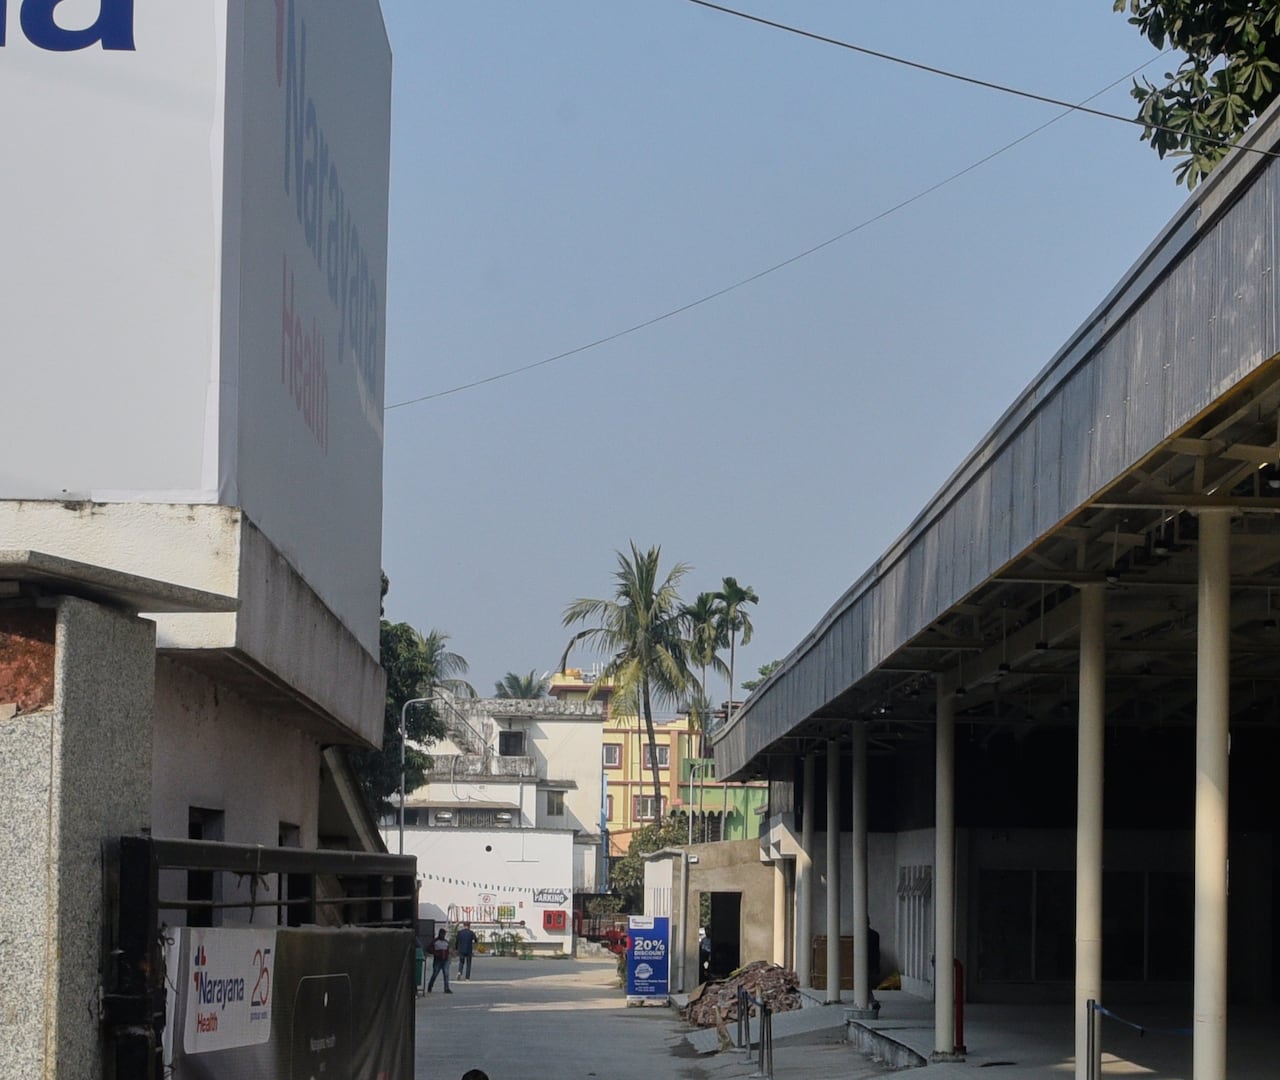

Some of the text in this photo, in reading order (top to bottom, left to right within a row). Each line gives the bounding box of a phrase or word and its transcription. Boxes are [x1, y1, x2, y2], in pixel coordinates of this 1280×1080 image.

[281, 250, 329, 457] Health
[534, 893, 566, 903] PARKING
[634, 940, 666, 951] 20%
[199, 971, 245, 1010] Narayana
[251, 948, 271, 1007] 25
[197, 1012, 218, 1033] Health
